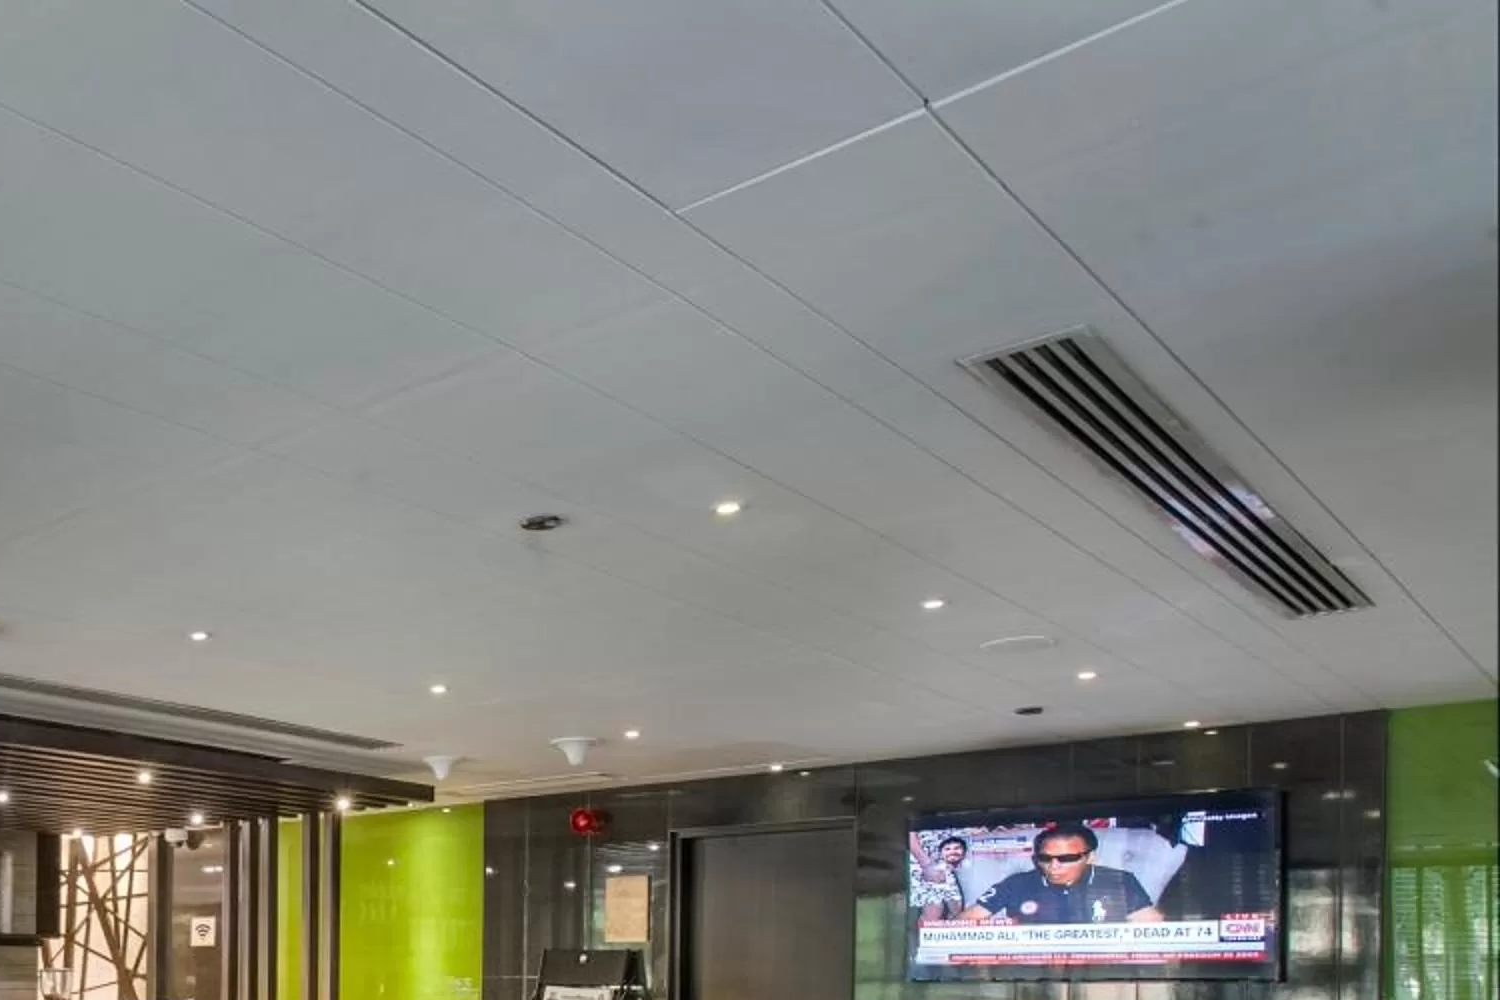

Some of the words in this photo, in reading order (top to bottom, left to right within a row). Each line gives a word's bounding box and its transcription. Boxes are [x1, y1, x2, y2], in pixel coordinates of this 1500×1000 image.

[923, 930, 995, 942] MUHAMMAD
[997, 930, 1020, 942] ALI,
[1133, 926, 1171, 939] DEAD
[1173, 926, 1192, 938] AT
[1197, 926, 1213, 937] 74
